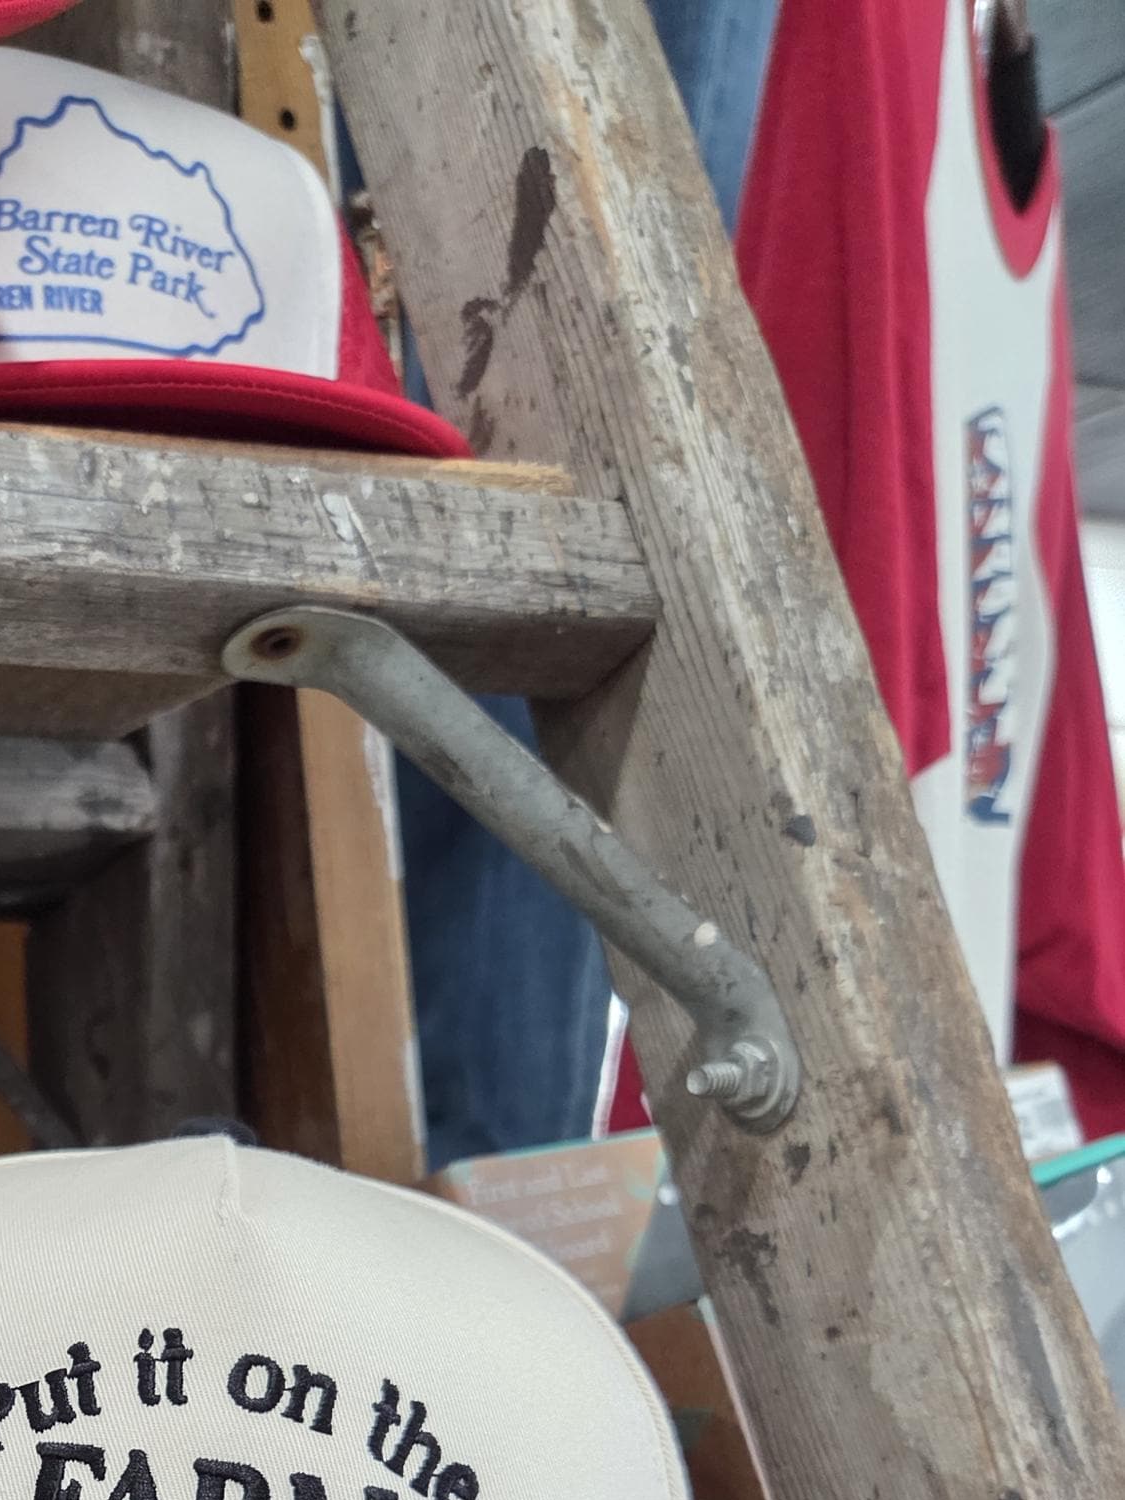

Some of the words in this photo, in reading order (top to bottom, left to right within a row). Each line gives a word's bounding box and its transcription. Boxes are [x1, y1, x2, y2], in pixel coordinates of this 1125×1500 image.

[17, 234, 115, 277] State
[128, 251, 216, 319] Park
[129, 213, 234, 273] River
[42, 284, 104, 316] RIVER
[133, 1327, 194, 1406] it
[226, 1353, 338, 1435] on
